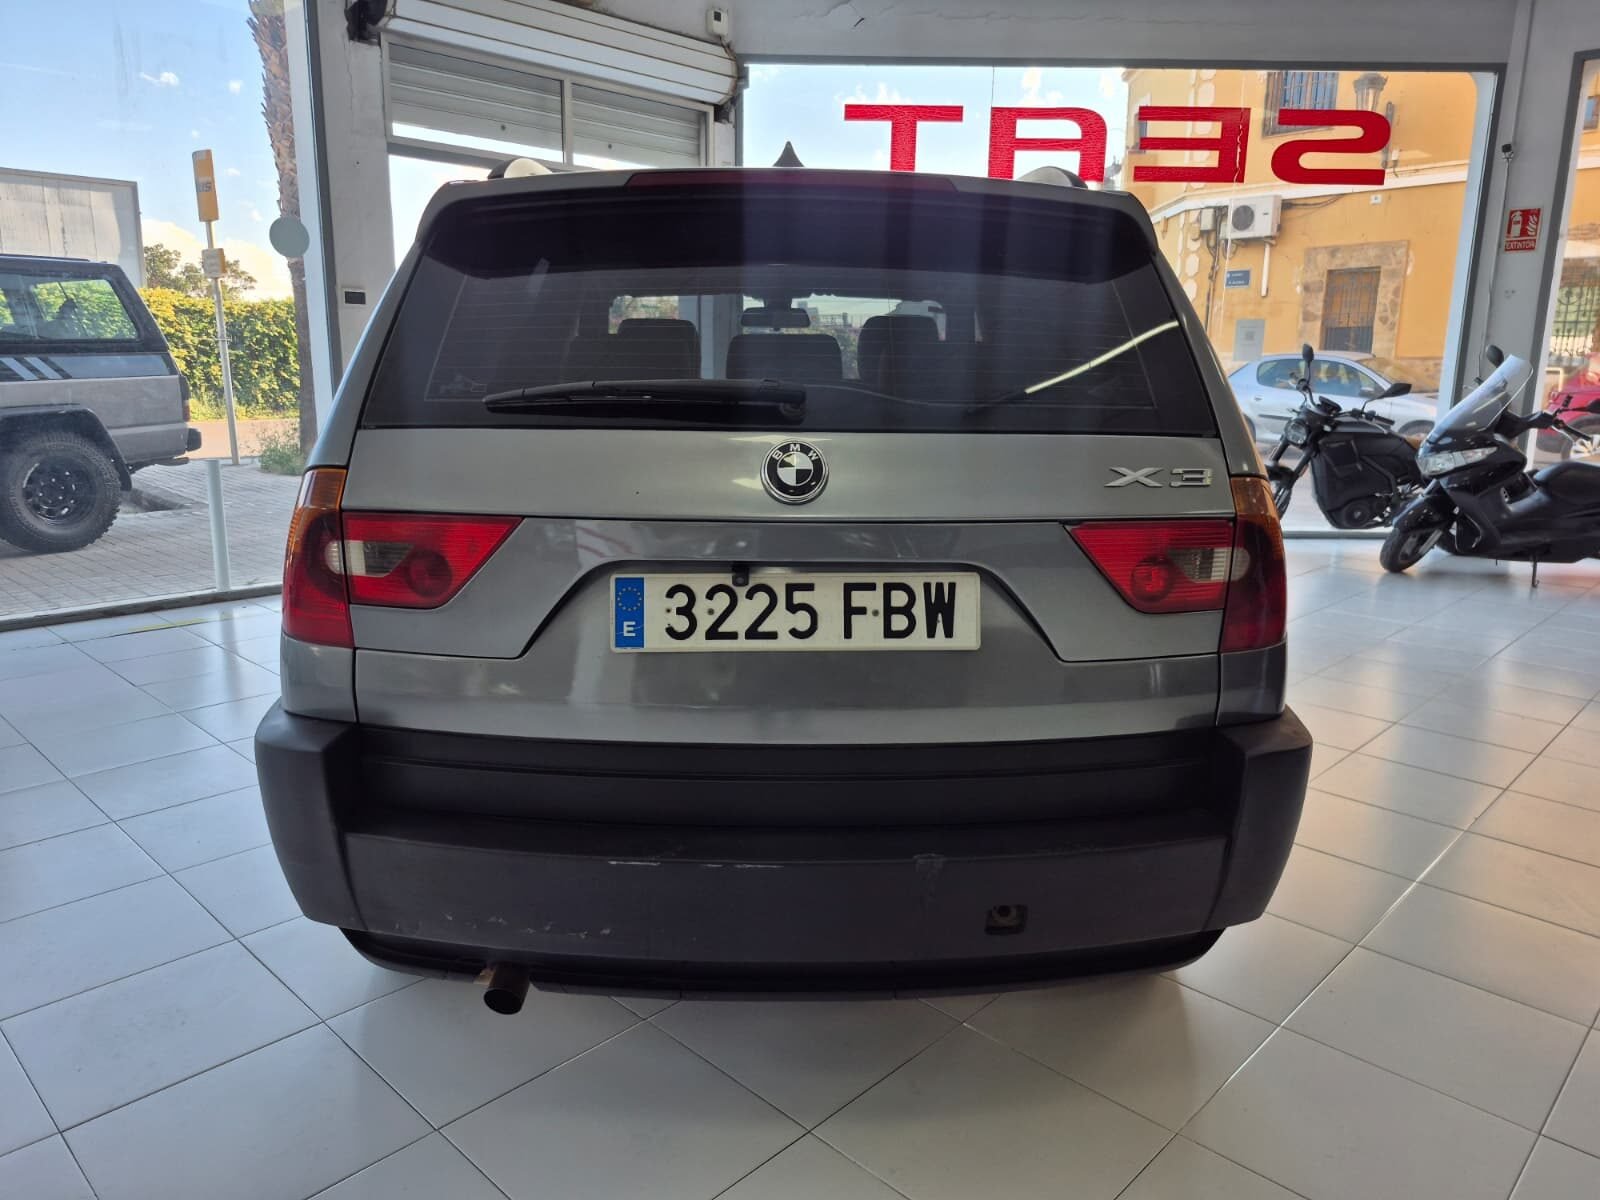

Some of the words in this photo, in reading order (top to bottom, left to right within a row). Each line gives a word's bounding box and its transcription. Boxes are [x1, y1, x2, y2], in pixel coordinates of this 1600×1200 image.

[772, 443, 819, 461] BMW
[1103, 466, 1212, 488] X3
[664, 582, 819, 641] 3225
[843, 581, 957, 640] FBW
[623, 620, 637, 637] E
